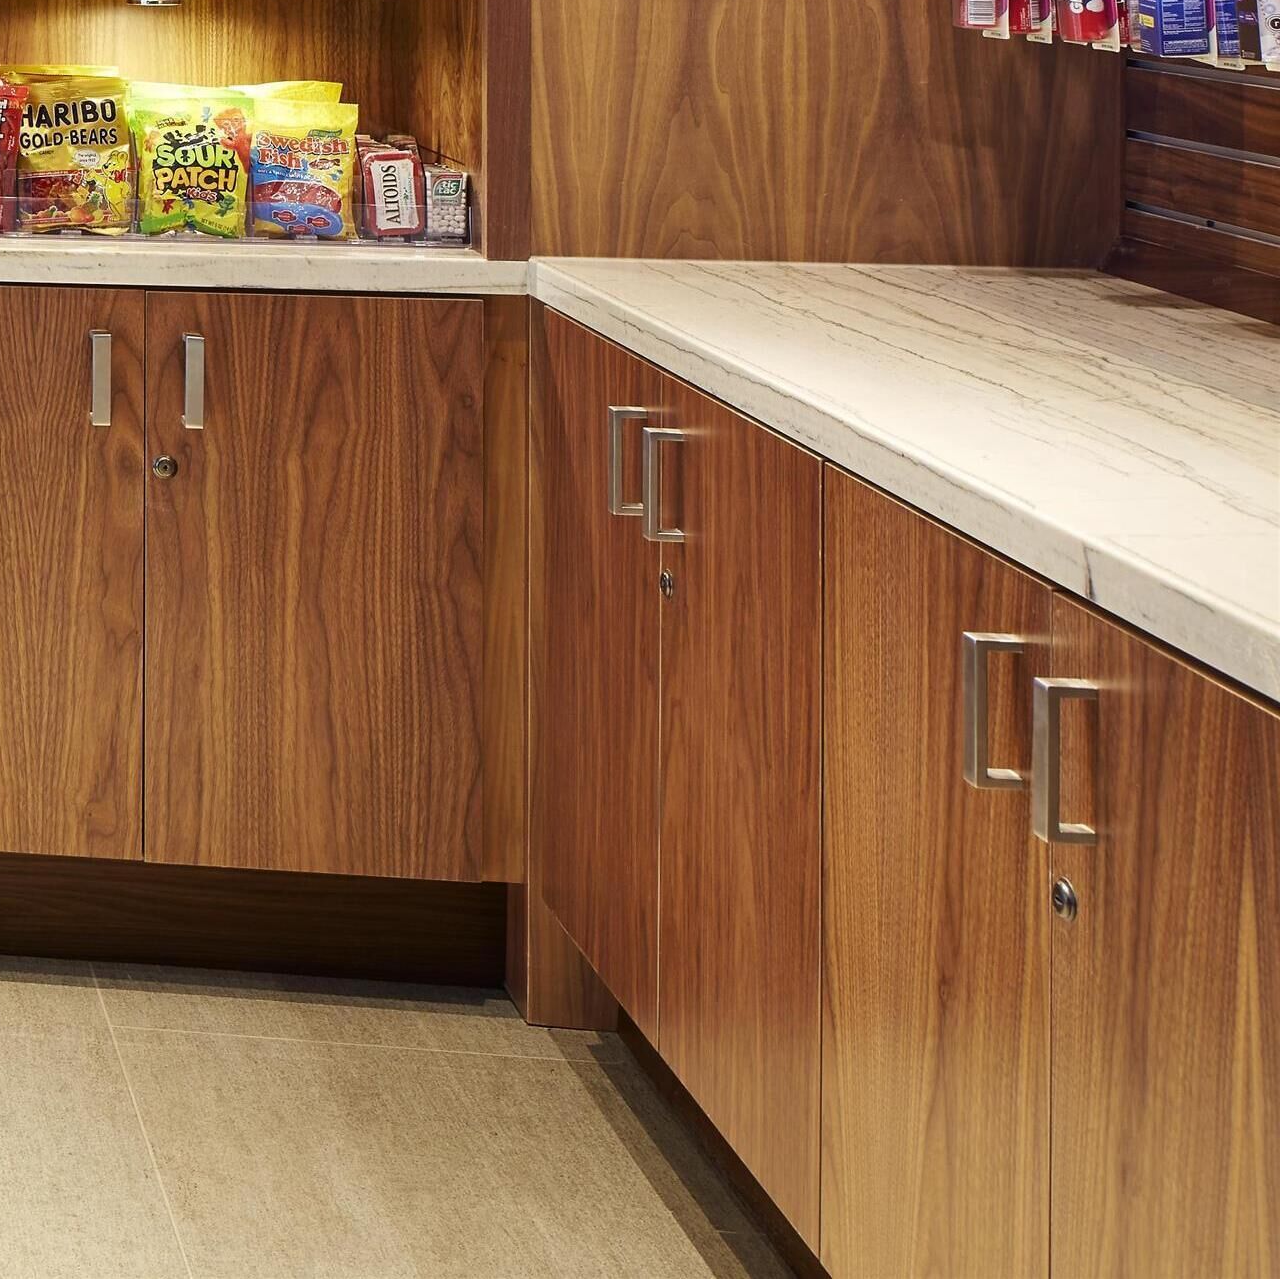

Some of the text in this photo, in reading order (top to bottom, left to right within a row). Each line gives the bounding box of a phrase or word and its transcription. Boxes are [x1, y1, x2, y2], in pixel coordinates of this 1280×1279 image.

[21, 98, 117, 129] HARIBO
[19, 127, 118, 149] GOLD-BEARS
[257, 131, 349, 154] Swedish
[156, 144, 235, 167] SOUR
[258, 148, 302, 170] Fish
[156, 168, 238, 192] PATCH
[186, 188, 218, 202] Kids
[381, 165, 399, 224] ALTOIDS
[439, 188, 457, 196] tac
